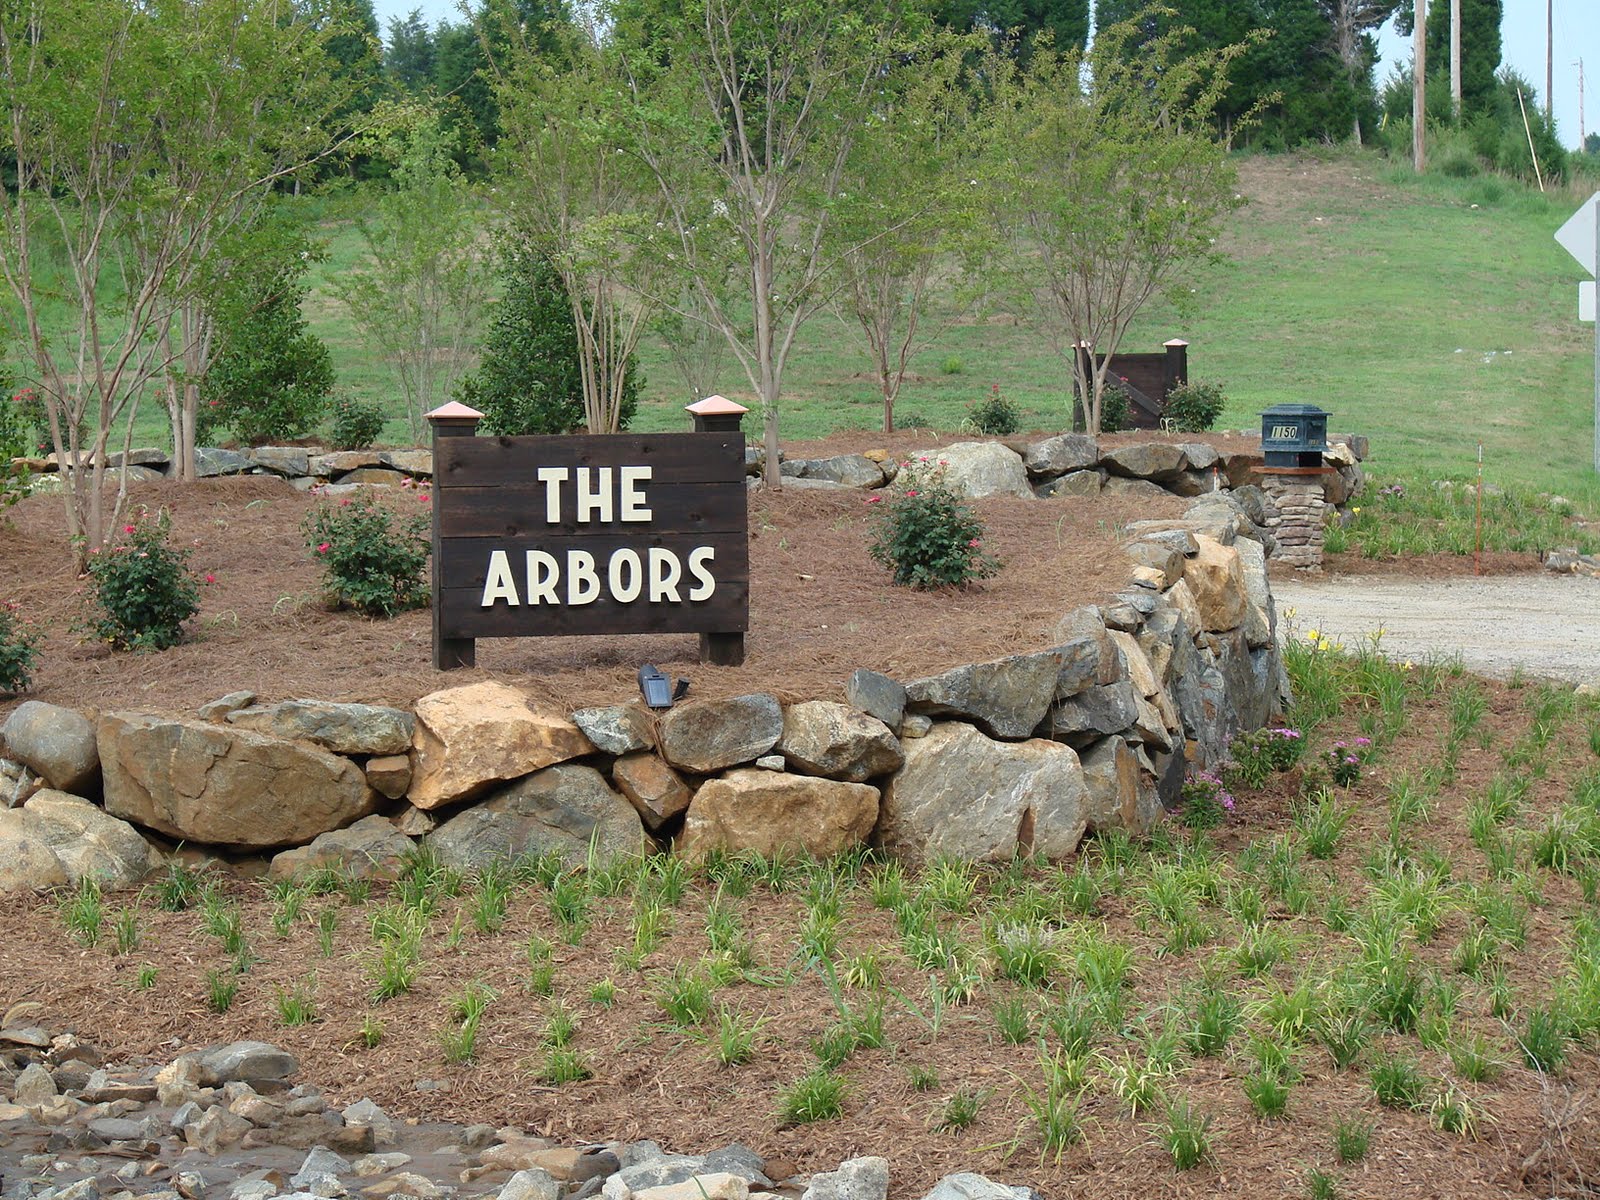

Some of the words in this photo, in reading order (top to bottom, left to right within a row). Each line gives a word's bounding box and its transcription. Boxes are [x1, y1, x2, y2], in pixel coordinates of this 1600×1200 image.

[1273, 427, 1296, 438] 1150
[537, 466, 653, 523] THE
[481, 547, 716, 606] ARBORS
